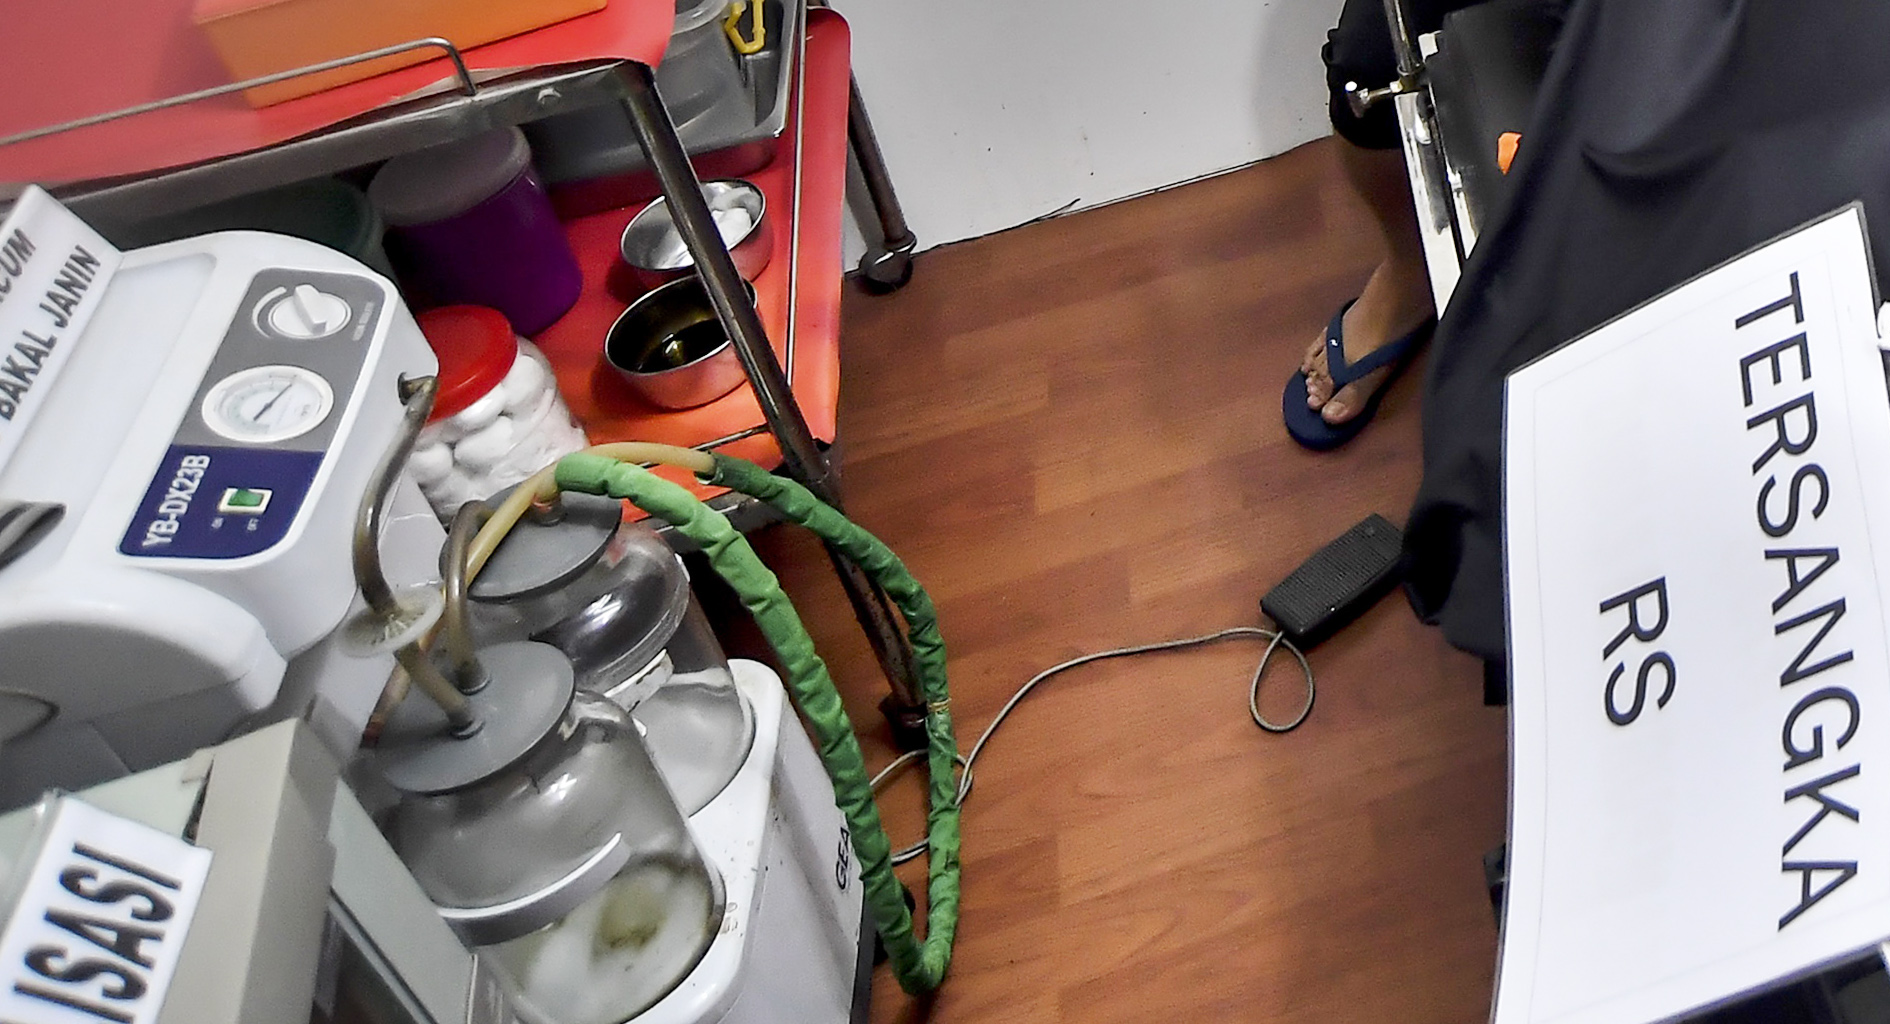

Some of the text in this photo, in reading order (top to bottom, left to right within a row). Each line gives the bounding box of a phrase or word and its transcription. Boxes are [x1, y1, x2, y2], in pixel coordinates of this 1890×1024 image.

[39, 244, 101, 328] JANIN
[142, 455, 211, 547] YB-DX23B
[1599, 576, 1677, 727] RS
[1734, 271, 1861, 932] TERSANGKA
[9, 841, 182, 1024] ISASI
